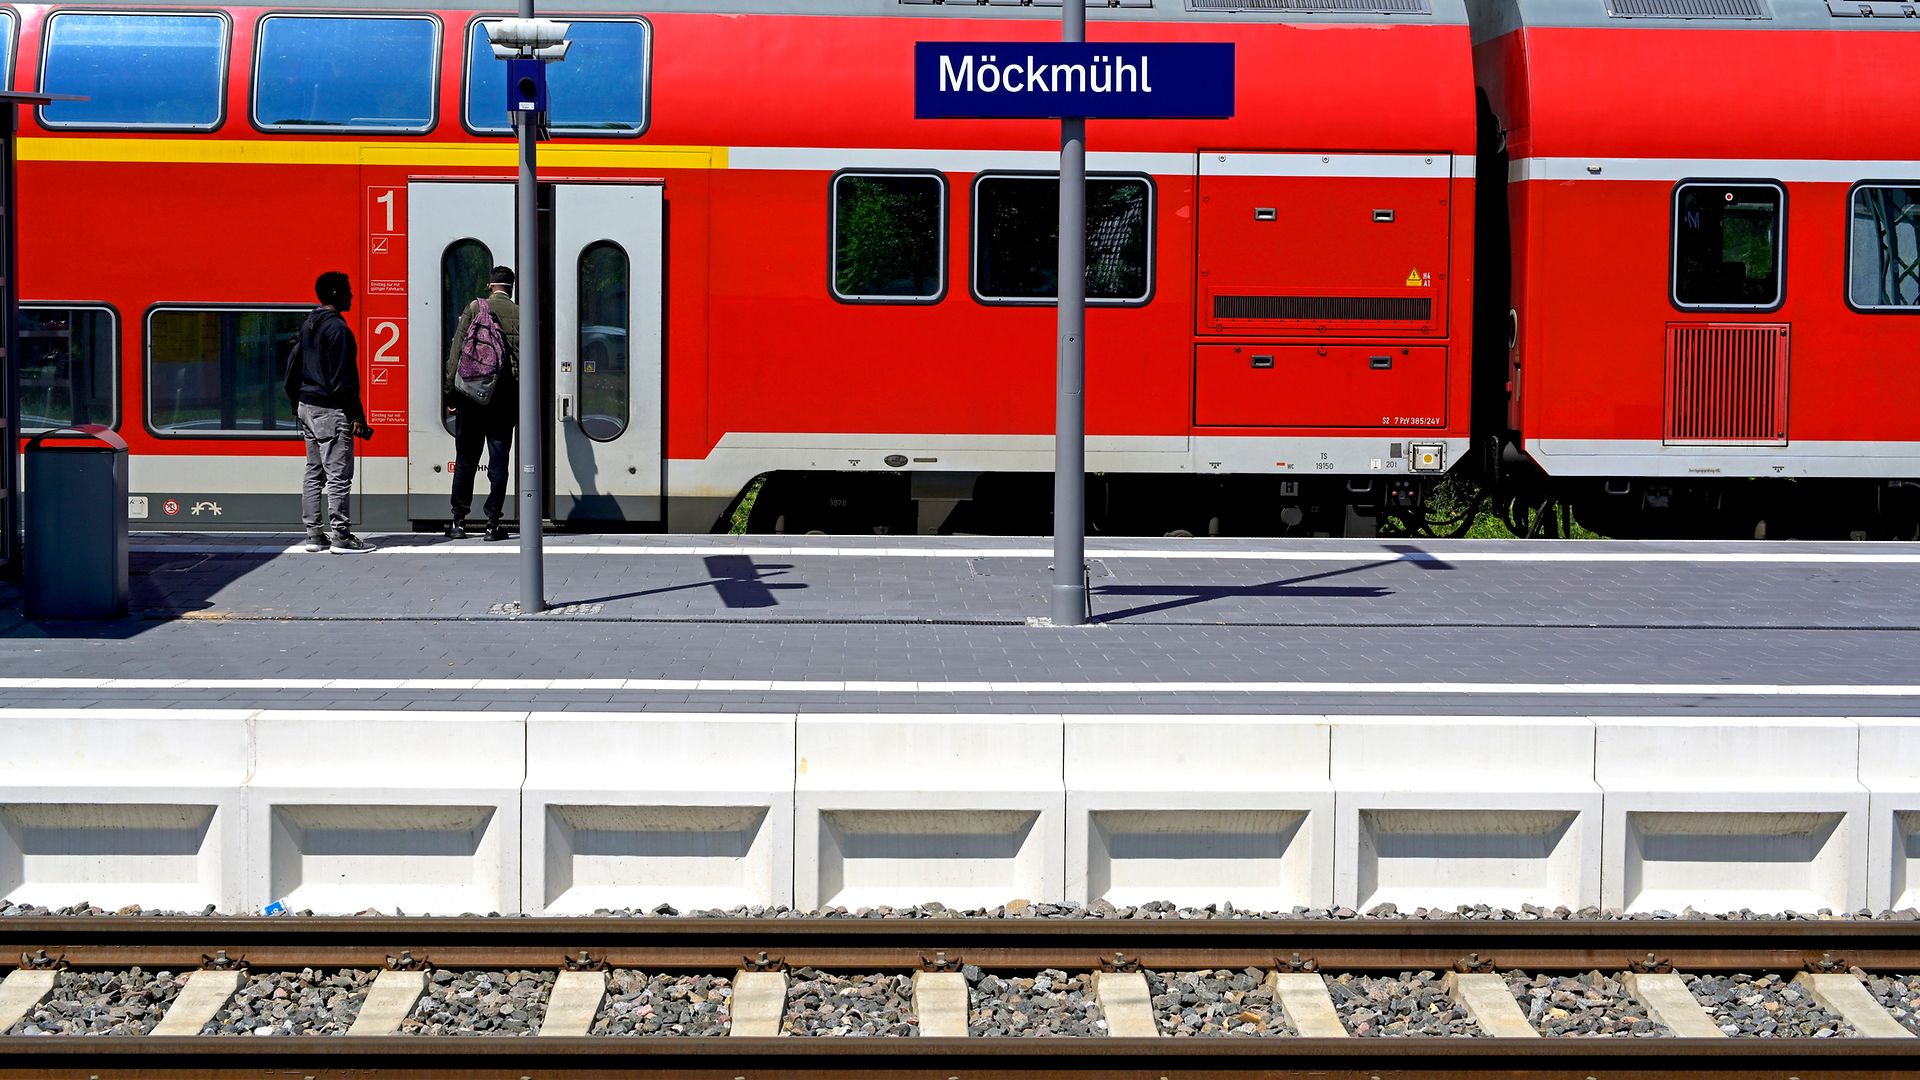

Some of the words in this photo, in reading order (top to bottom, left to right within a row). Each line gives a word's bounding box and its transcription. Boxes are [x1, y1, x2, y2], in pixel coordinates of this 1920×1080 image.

[938, 54, 1152, 94] Möckmühl
[377, 190, 394, 231] 1
[373, 321, 400, 362] 2
[1320, 452, 1328, 460] TS
